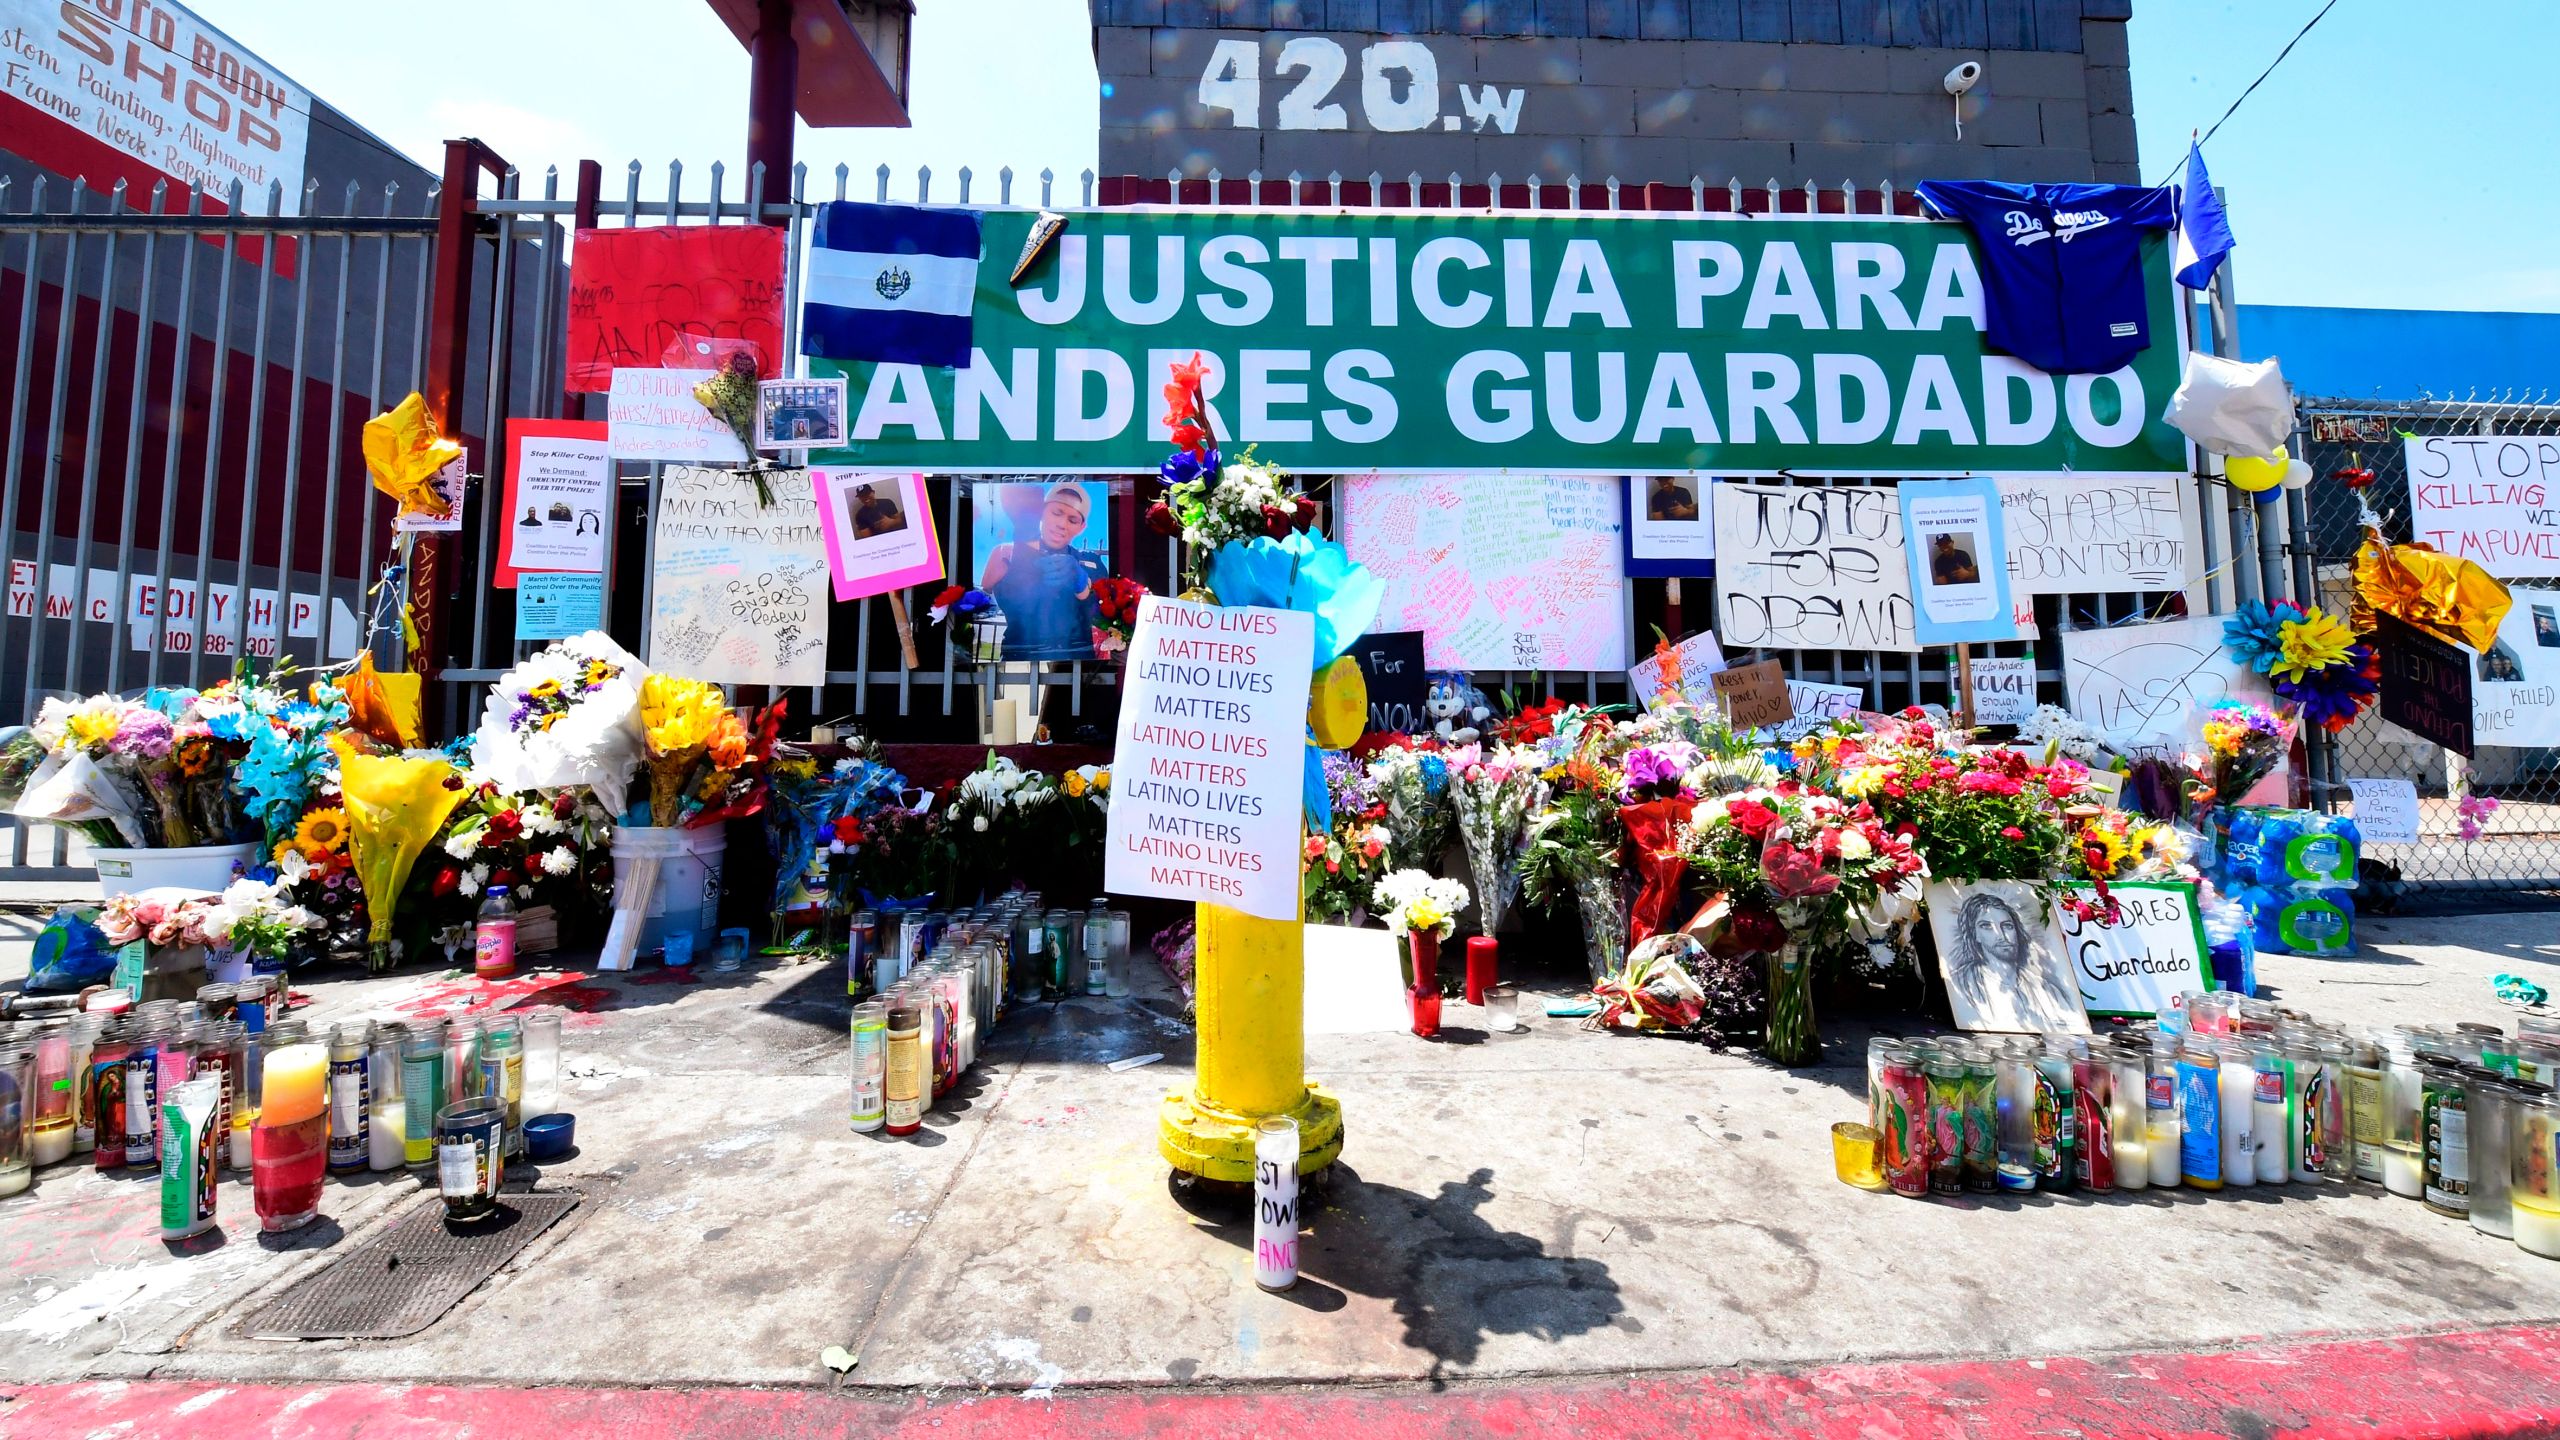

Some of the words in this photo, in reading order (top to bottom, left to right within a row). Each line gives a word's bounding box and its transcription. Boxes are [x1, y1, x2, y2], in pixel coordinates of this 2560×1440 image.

[57, 0, 282, 152] SHOP
[190, 32, 286, 121] BODY
[5, 61, 82, 122] Frame
[96, 106, 148, 158] Work
[77, 63, 166, 138] Painting
[1016, 233, 1632, 329] JUSTICIA
[1672, 239, 1987, 331] PARA
[851, 347, 1399, 443] ANDRES
[1445, 350, 2146, 448] GUARDADO
[530, 450, 549, 458] Stop
[551, 451, 575, 459] Killer
[577, 453, 604, 462] Cops!
[2419, 438, 2560, 481] STOP
[527, 476, 568, 484] COMMUNITY
[568, 478, 602, 487] CONTROL
[540, 467, 551, 475] We
[553, 467, 588, 477] Demand:
[2417, 484, 2547, 510] KILLING
[662, 521, 718, 542] WHEN
[1935, 518, 1960, 526] KILLER
[2525, 508, 2560, 527] WI
[2425, 529, 2560, 563] IMPUNI
[561, 576, 601, 584] Community
[1747, 547, 1881, 593] FOR
[413, 542, 436, 673] ANDRES
[1145, 605, 1213, 630] LATINO
[1220, 613, 1278, 636] LIVES
[1158, 637, 1257, 666] MATTERS
[1370, 650, 1405, 676] For
[1139, 660, 1210, 688] LATINO
[1217, 669, 1274, 695] LIVES
[1717, 671, 1746, 688] Rest
[1154, 694, 1252, 724] MATTERS
[1787, 684, 1862, 720] NDRES
[1981, 695, 2020, 713] enough
[2509, 685, 2555, 707] KILLED
[1370, 701, 1427, 734] NOW
[1133, 722, 1205, 750] LATINO
[1212, 732, 1268, 758] LIVES
[1150, 757, 1247, 788] MATTERS
[1127, 778, 1200, 808] LATINO
[1207, 790, 1263, 817] LIVES
[2351, 780, 2408, 799] Justicia
[2352, 814, 2392, 826] Andres
[2368, 798, 2399, 813] Para
[1148, 812, 1242, 845] MATTERS
[1128, 833, 1201, 862] LATINO
[1208, 846, 1263, 873] LIVES
[1151, 866, 1244, 897] MATTERS
[2079, 939, 2191, 983] Guardado
